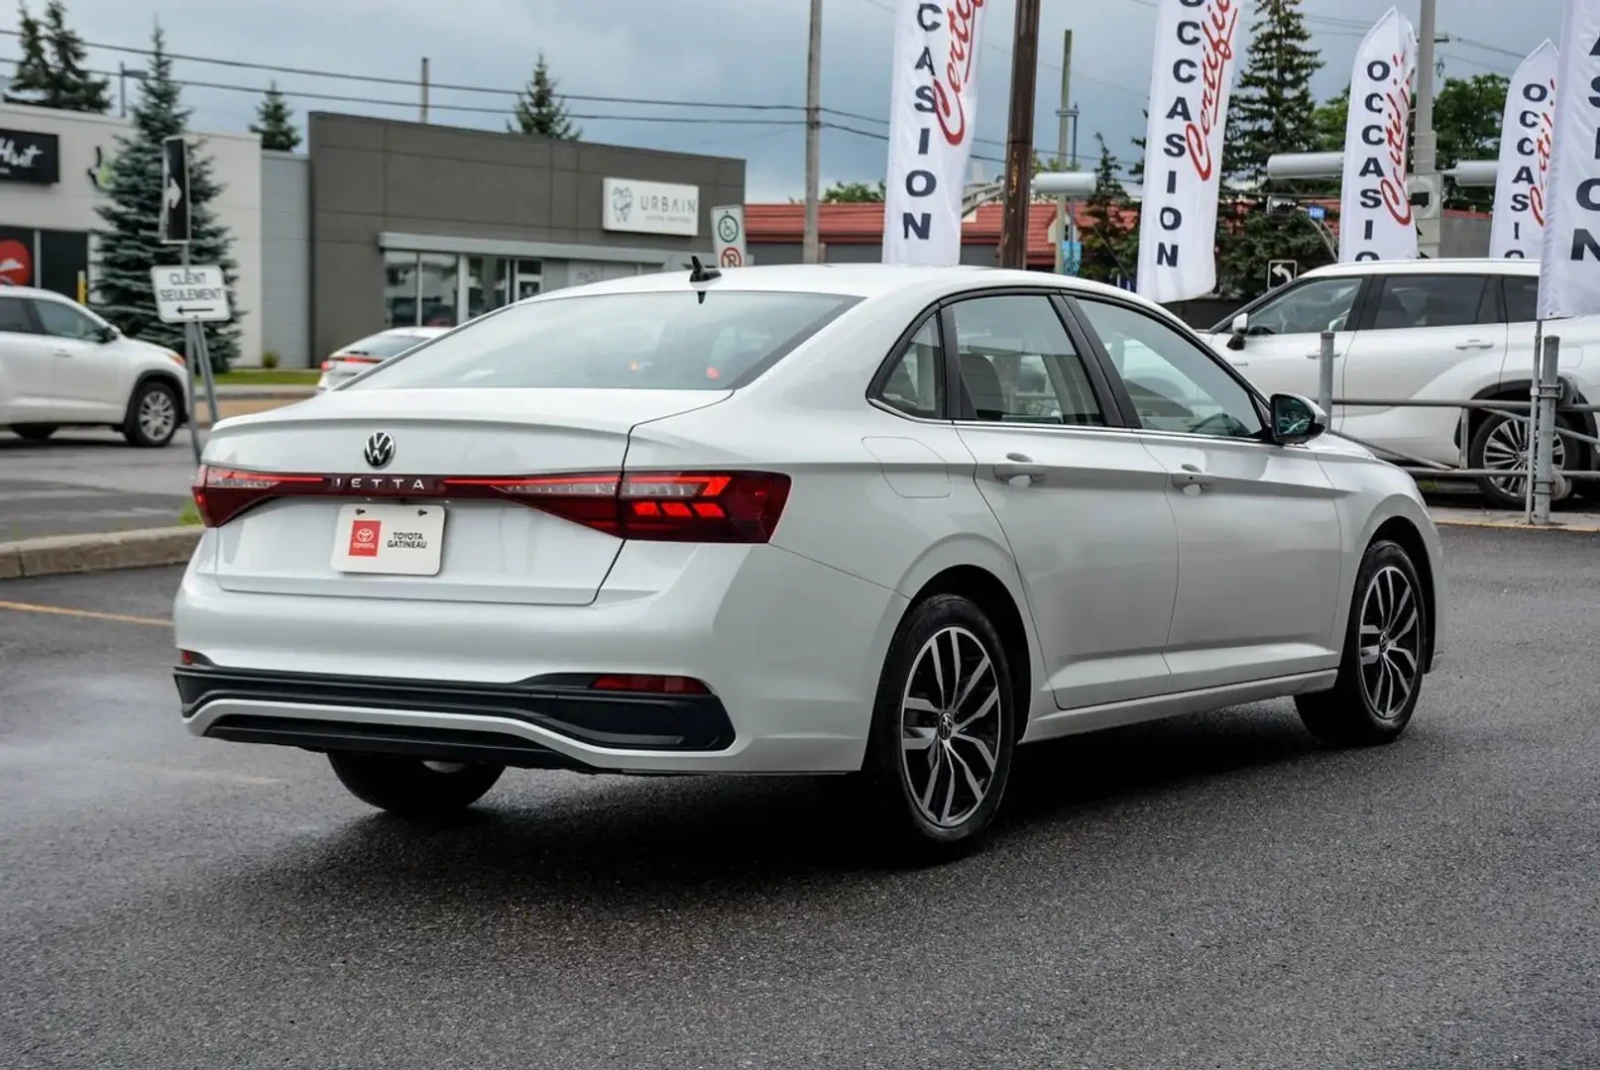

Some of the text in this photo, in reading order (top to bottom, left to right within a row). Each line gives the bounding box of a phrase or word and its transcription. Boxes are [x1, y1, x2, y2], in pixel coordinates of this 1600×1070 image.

[1156, 0, 1205, 268] CCASION
[640, 195, 696, 214] URBAIN
[169, 272, 206, 286] CLIENT
[160, 288, 221, 302] SEULEMENT
[391, 532, 423, 540] TOYOTA
[387, 540, 427, 549] GATINEAU
